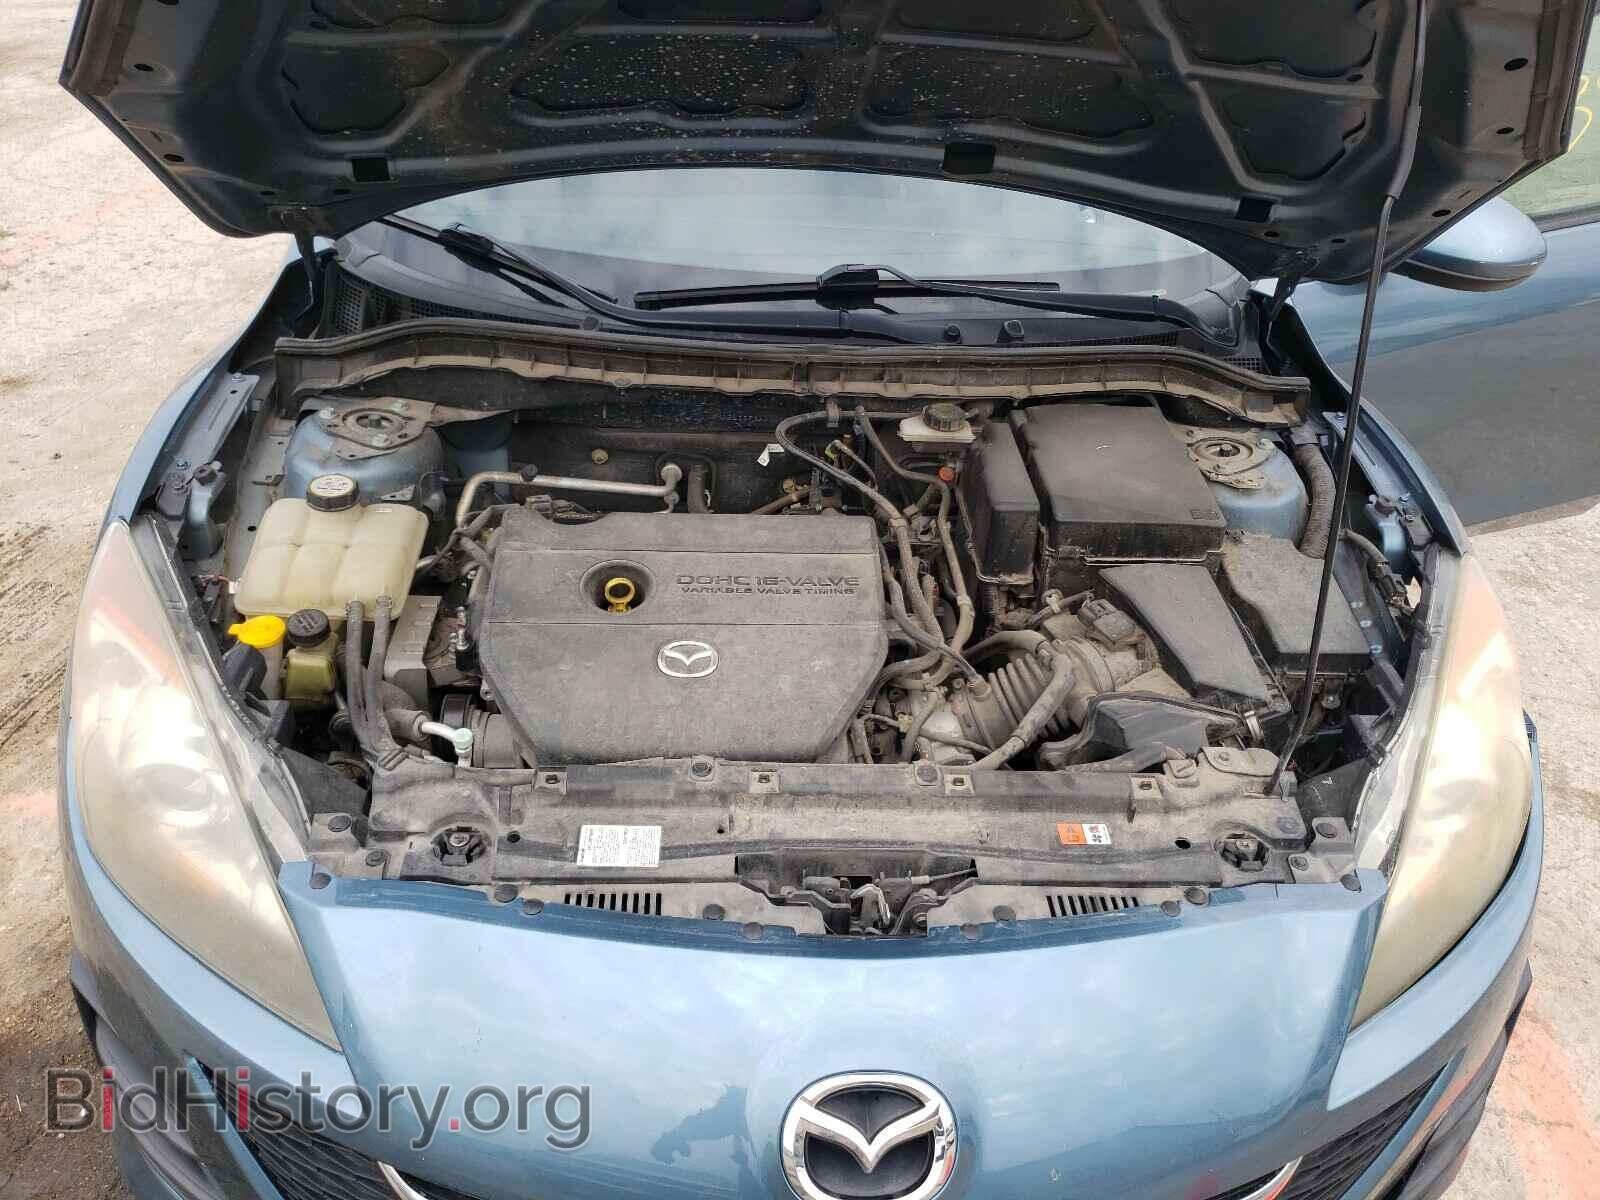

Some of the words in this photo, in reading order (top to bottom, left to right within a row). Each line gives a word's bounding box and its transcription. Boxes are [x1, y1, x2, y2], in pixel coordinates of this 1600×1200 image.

[676, 575, 750, 585] DOHC
[755, 576, 861, 587] 16-VALVE
[757, 587, 801, 595] VALVE
